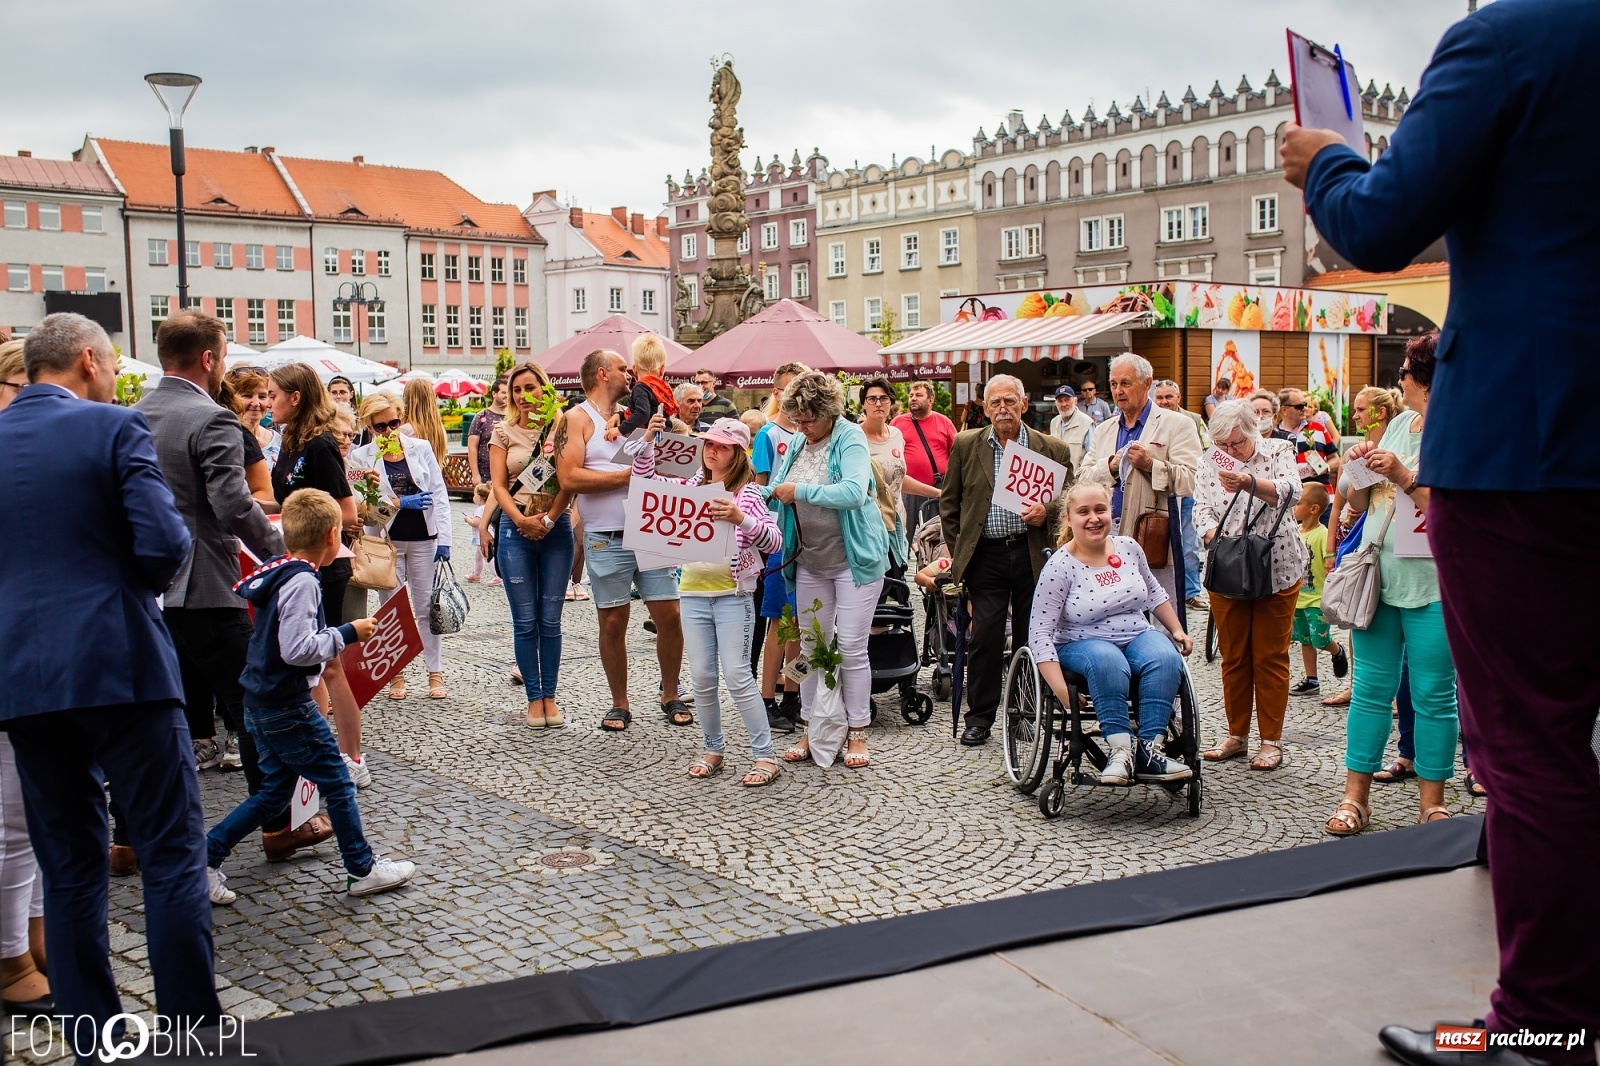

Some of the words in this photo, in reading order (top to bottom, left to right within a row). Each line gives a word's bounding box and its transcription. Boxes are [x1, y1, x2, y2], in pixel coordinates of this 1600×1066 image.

[889, 369, 909, 379] Italia
[919, 366, 933, 375] Ciao
[654, 438, 698, 457] UDA
[1212, 450, 1235, 468] DUDA
[1009, 454, 1055, 491] DUDA
[1005, 473, 1053, 504] 2020
[641, 491, 715, 523] DUDA
[639, 512, 715, 543] 2020
[1094, 570, 1119, 581] DUDA
[1099, 575, 1122, 587] 2020
[378, 606, 408, 667] DUDA
